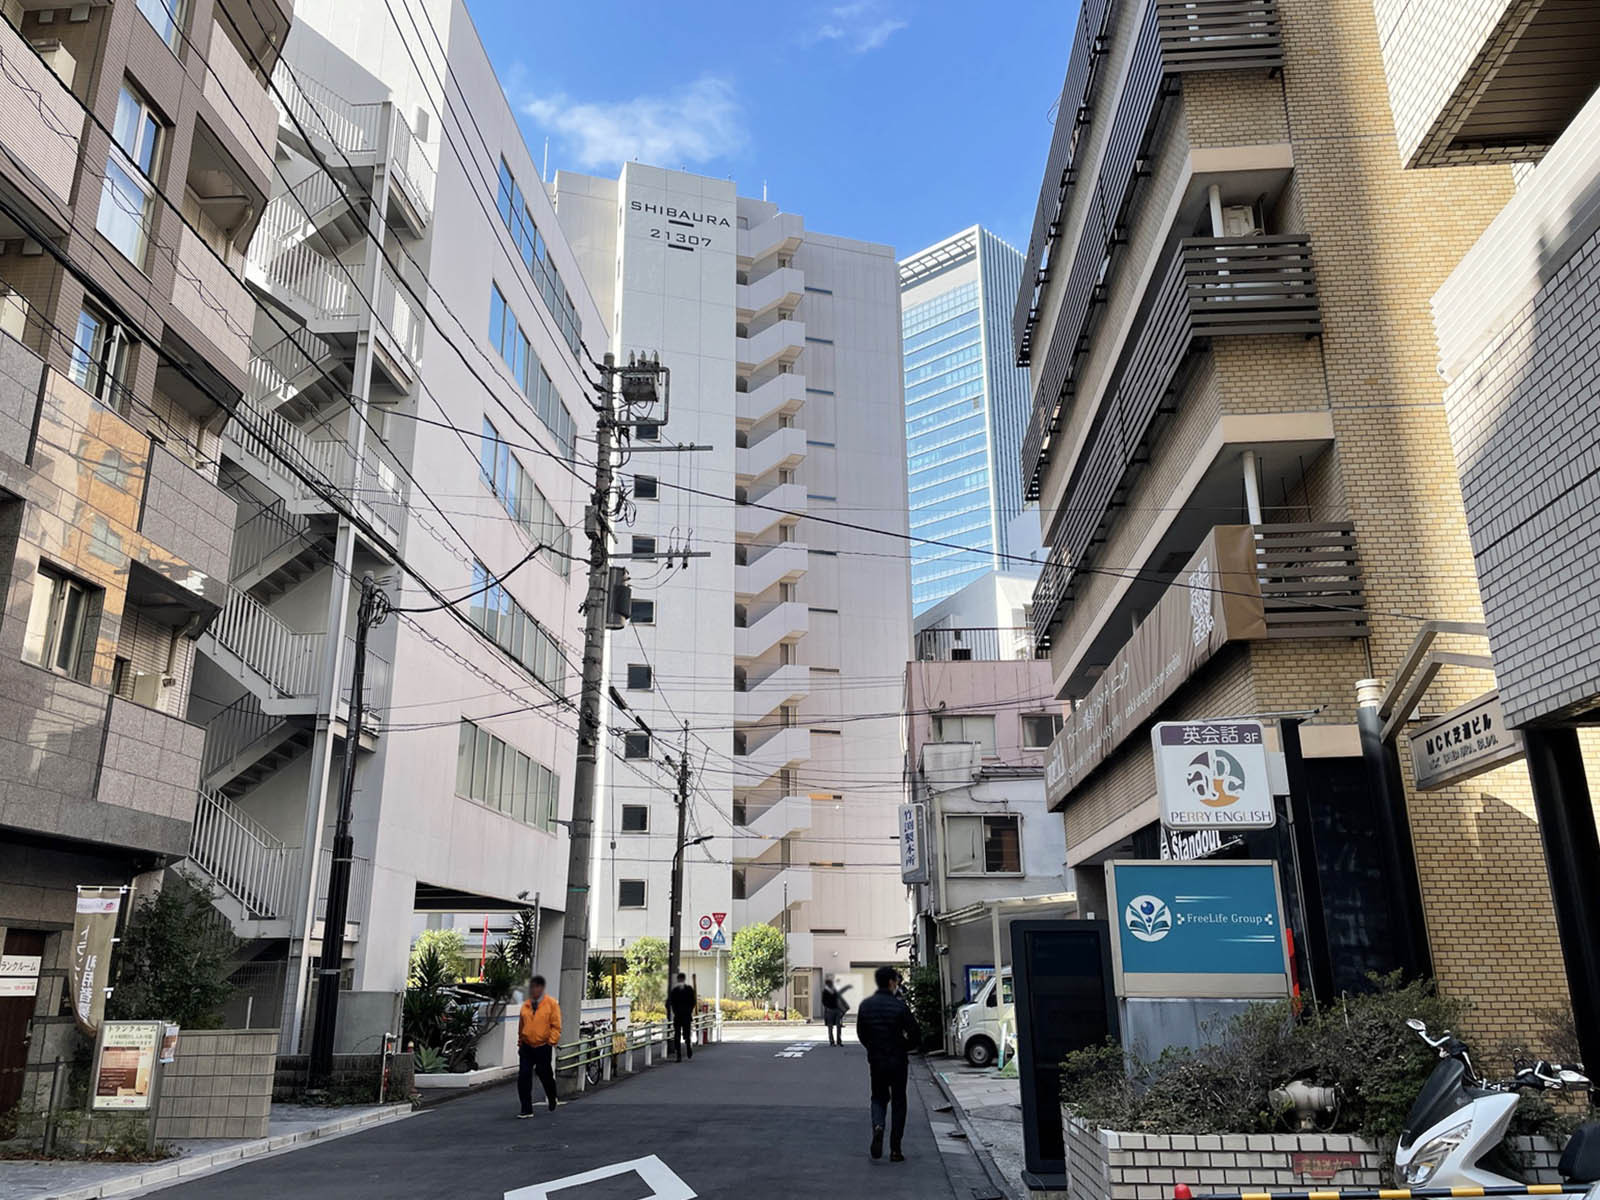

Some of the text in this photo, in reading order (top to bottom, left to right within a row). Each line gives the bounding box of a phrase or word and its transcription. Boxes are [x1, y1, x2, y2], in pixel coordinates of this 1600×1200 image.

[631, 201, 731, 228] SHIBAURA
[650, 228, 712, 247] 21307
[1183, 726, 1259, 744] 英会話 3F
[1171, 811, 1272, 822] PERRY ENGLISH
[1187, 913, 1263, 925] FreeLife Group
